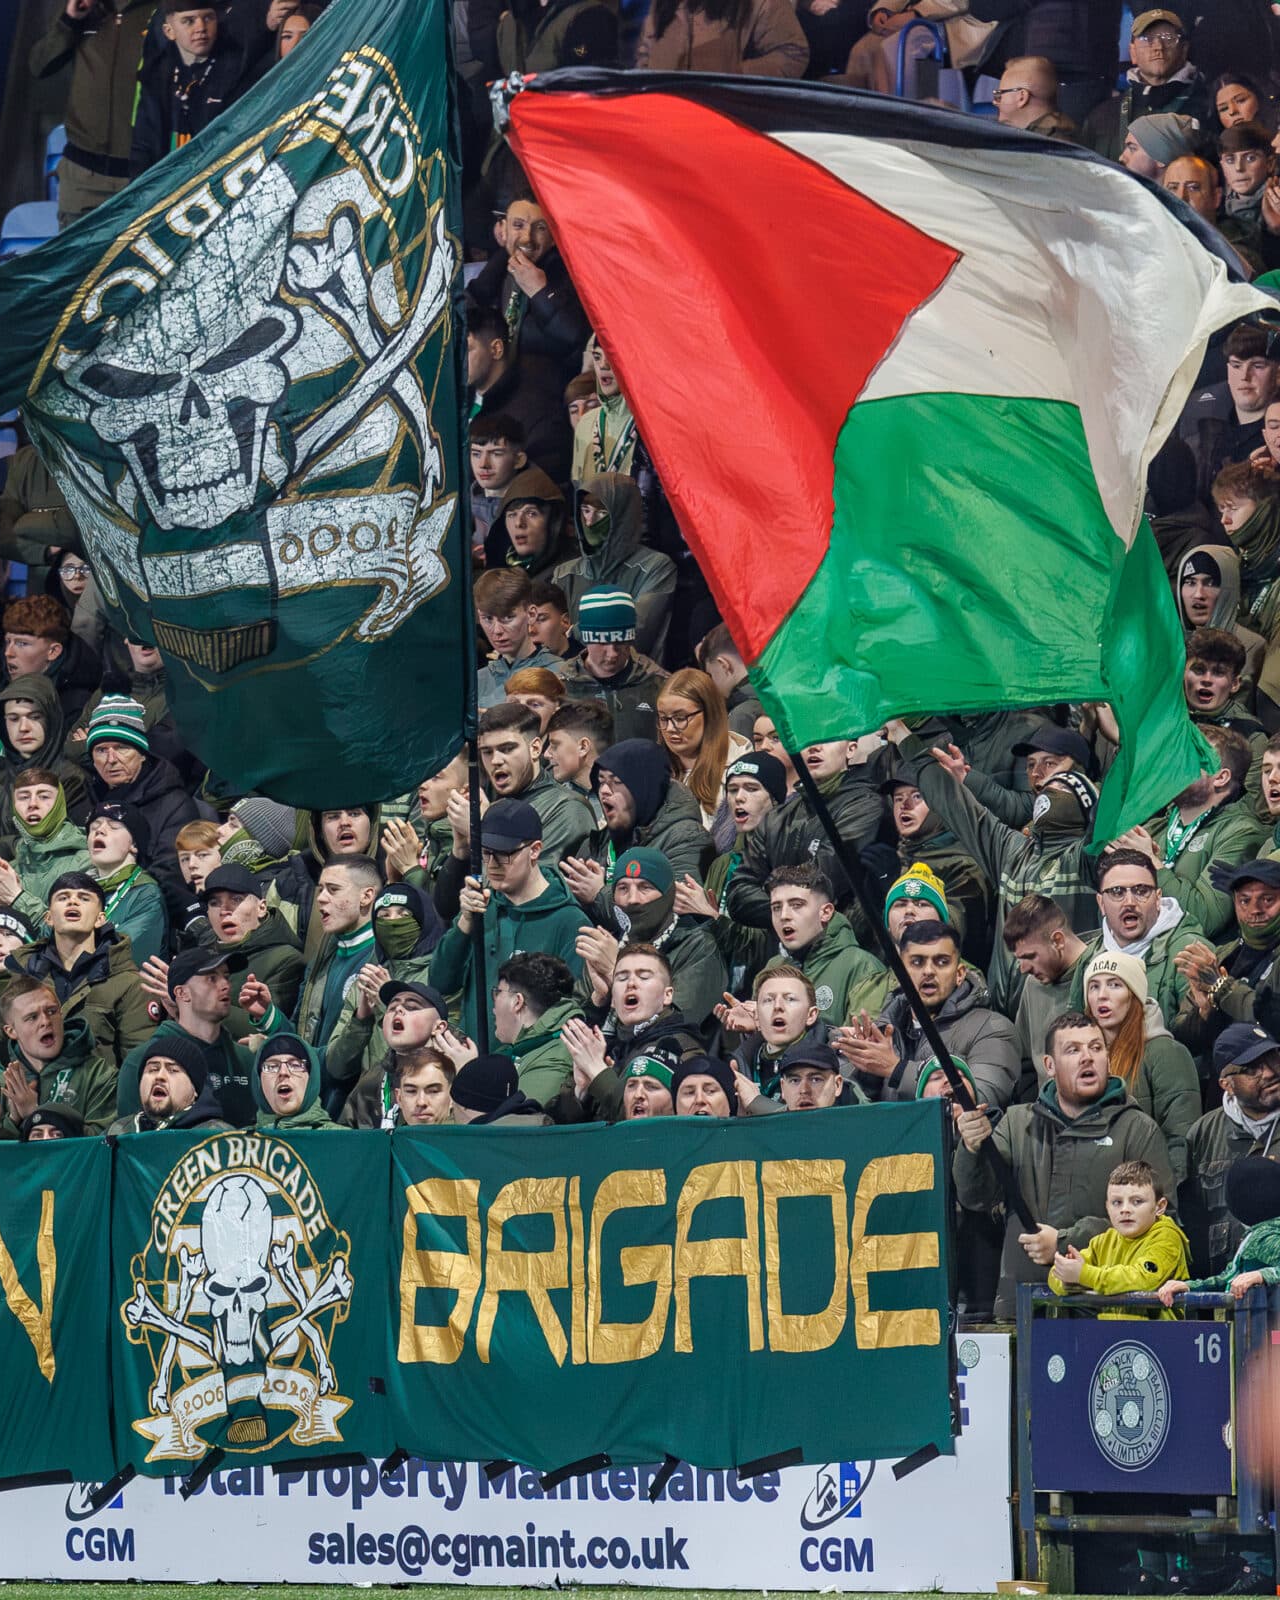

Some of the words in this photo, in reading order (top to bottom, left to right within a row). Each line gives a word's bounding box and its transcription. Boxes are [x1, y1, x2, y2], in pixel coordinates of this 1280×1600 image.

[1093, 960, 1118, 972] ACAB
[154, 1141, 221, 1253] GREEN
[226, 1136, 326, 1241] BRIGADE
[397, 1153, 940, 1368] BRIGADE
[1194, 1333, 1221, 1364] 16
[183, 1386, 224, 1415] 2006
[1151, 1409, 1163, 1440] CLUB
[1111, 1440, 1149, 1462] LIMITED
[65, 1527, 136, 1562] CGM
[308, 1523, 690, 1576] sales@cgmaint.co.uk
[799, 1537, 875, 1572] CGM
